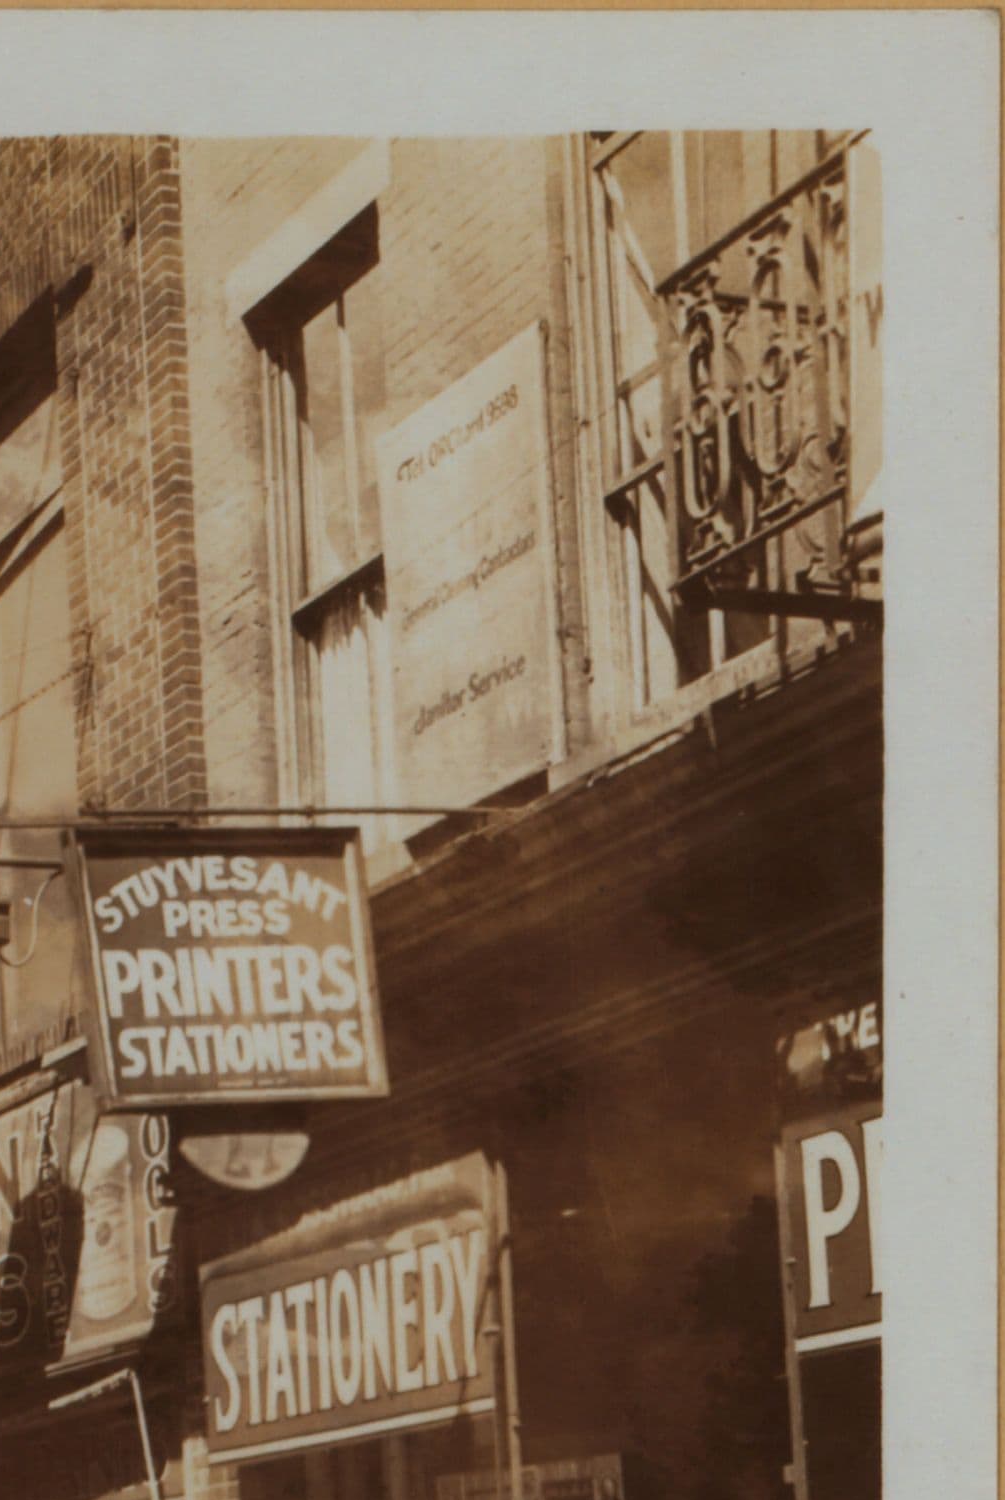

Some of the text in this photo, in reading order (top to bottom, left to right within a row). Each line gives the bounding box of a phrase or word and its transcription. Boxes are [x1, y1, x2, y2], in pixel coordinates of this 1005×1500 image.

[467, 654, 527, 704] Service
[95, 855, 346, 932] STUYVESANT
[162, 899, 291, 938] PRESS
[101, 945, 357, 1018] PRINTERS
[119, 1020, 364, 1077] STATIONERS
[211, 1229, 483, 1433] STATIONERY
